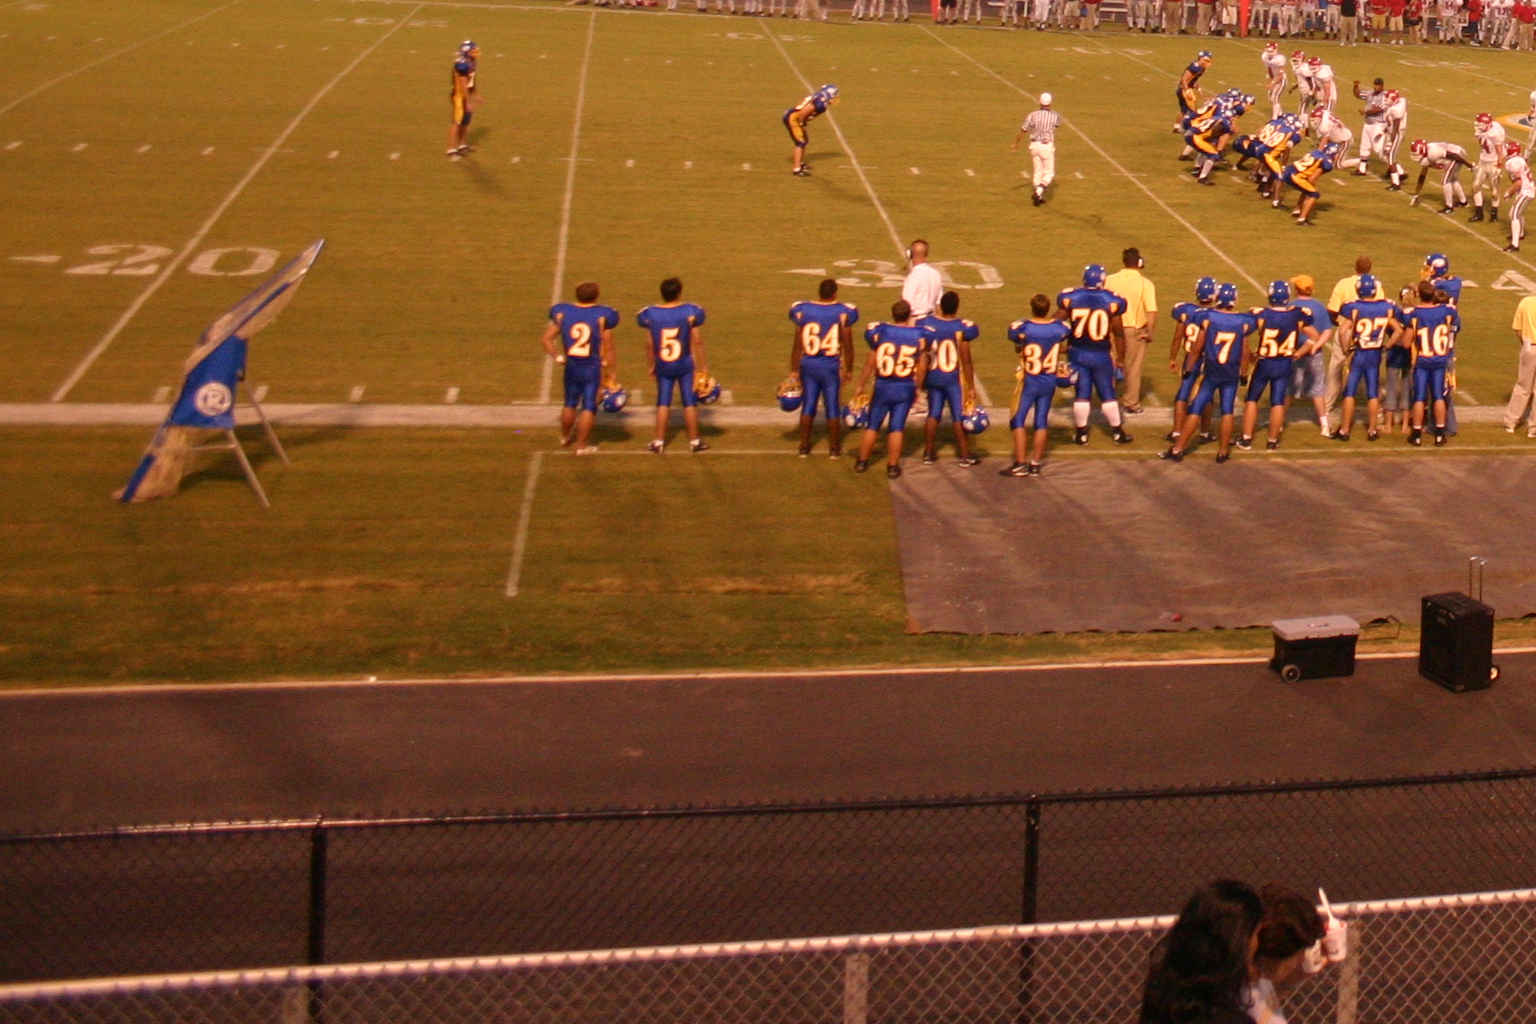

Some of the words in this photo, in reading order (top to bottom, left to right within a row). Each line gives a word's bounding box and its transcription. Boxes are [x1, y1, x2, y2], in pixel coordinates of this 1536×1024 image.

[63, 244, 281, 276] 20
[567, 322, 592, 357] 2
[801, 322, 840, 357] 64
[1071, 308, 1110, 342] 70
[1355, 317, 1389, 350] 27
[1416, 324, 1449, 357] 16
[659, 327, 682, 362] 5
[875, 342, 918, 377] 65
[927, 338, 958, 374] 0
[1023, 342, 1061, 376] 34
[1213, 331, 1237, 365] 7
[1259, 328, 1298, 358] 54
